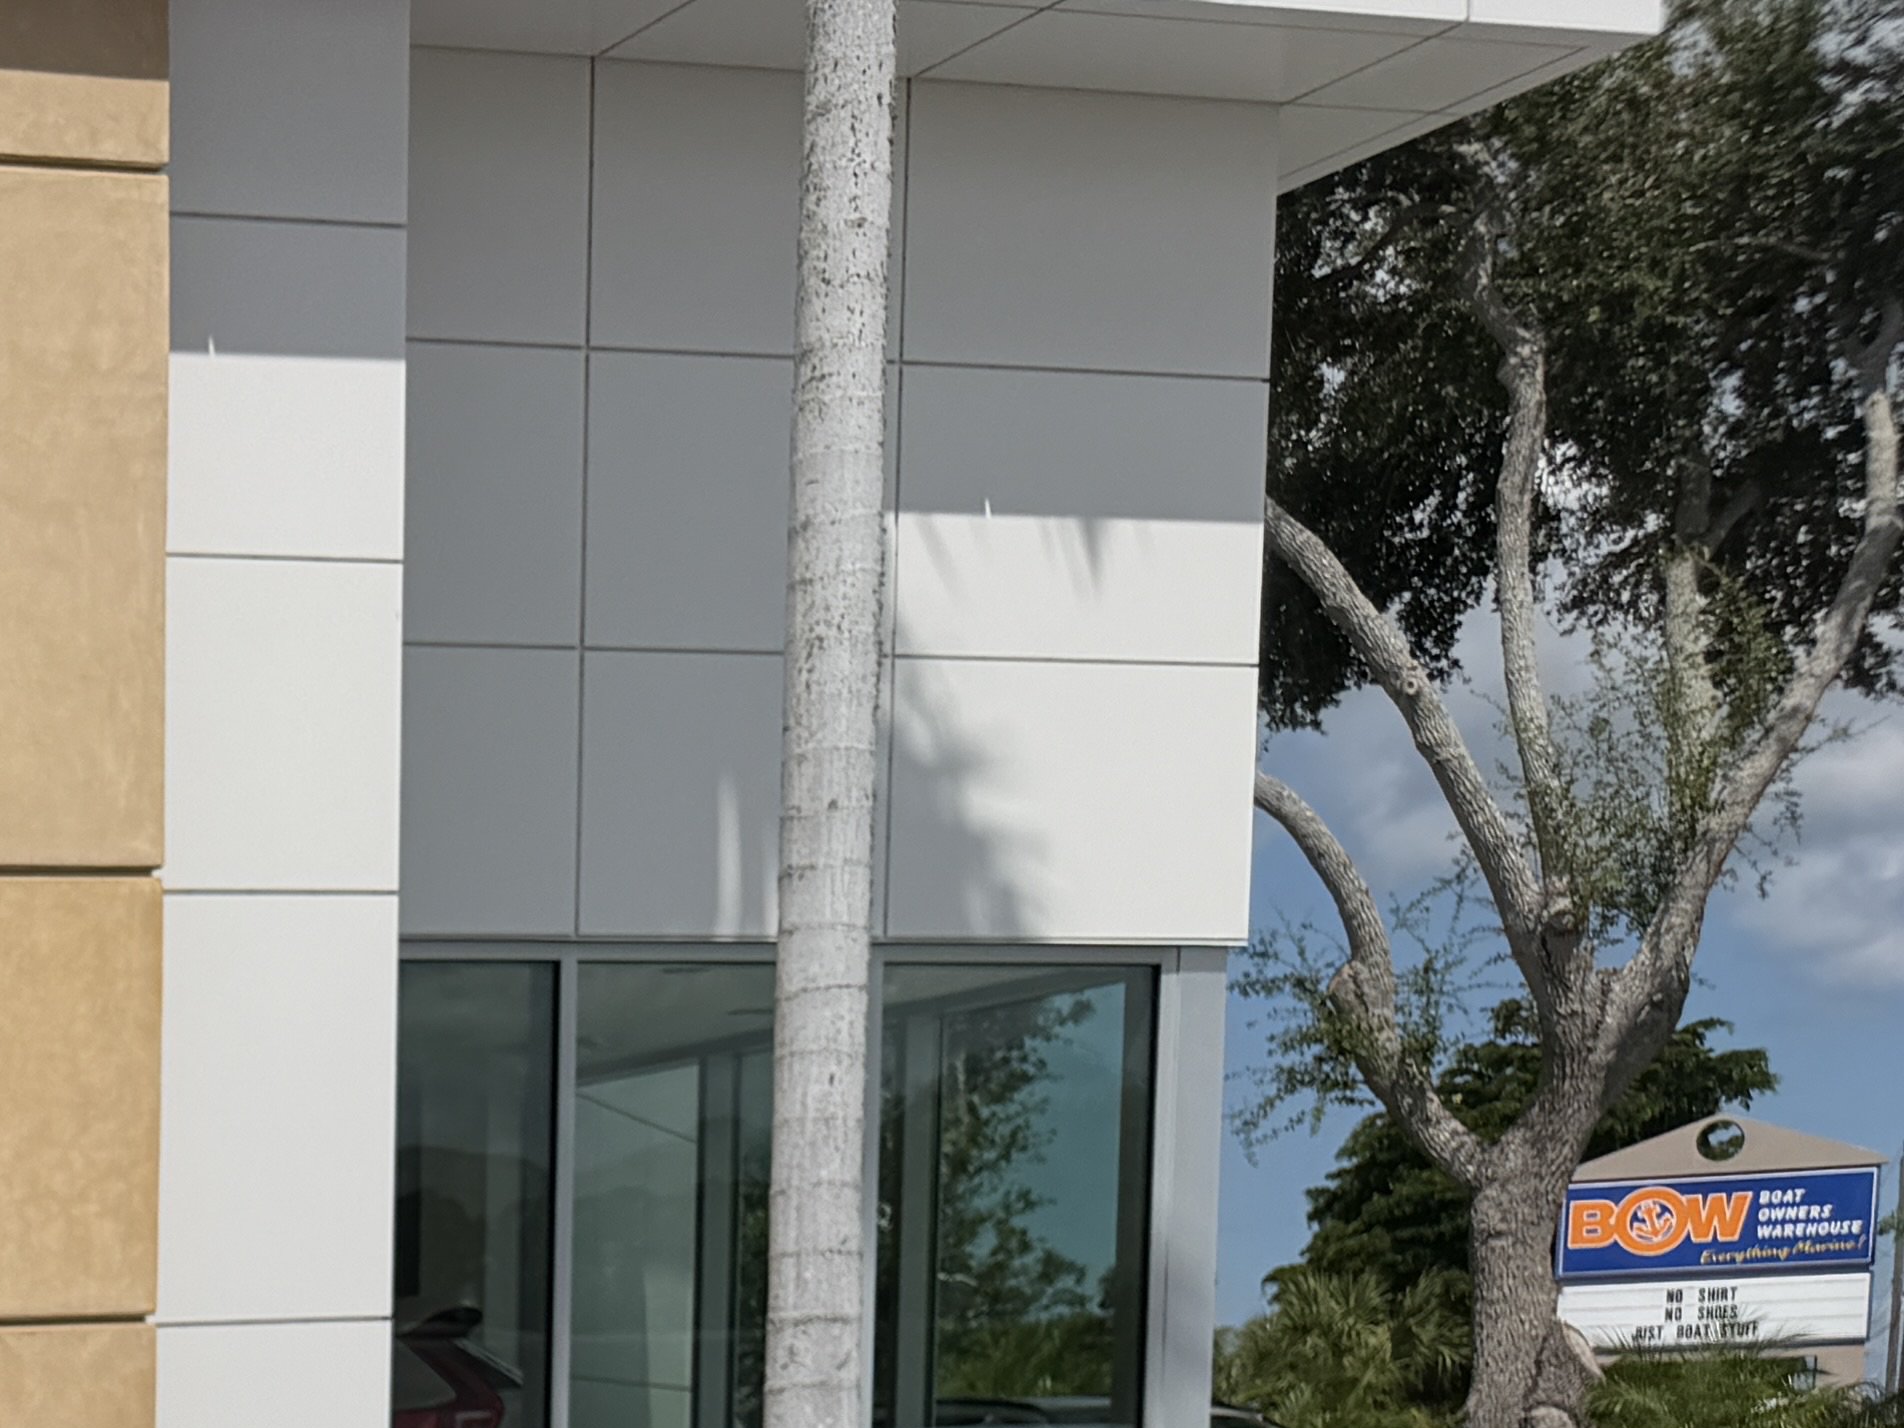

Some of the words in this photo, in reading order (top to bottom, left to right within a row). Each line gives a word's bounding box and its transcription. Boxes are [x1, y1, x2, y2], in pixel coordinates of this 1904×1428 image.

[1759, 1188, 1806, 1205] BOAT
[1567, 1185, 1754, 1257] BOW
[1758, 1204, 1834, 1222] OWNERS
[1757, 1219, 1864, 1240] WAREHOUSE
[1665, 1288, 1683, 1304] NO
[1698, 1286, 1738, 1304] SHIRT
[1664, 1306, 1682, 1322] NO
[1697, 1304, 1738, 1321] SHOES
[1676, 1322, 1711, 1339] BOAT
[1719, 1320, 1758, 1339] STUFF
